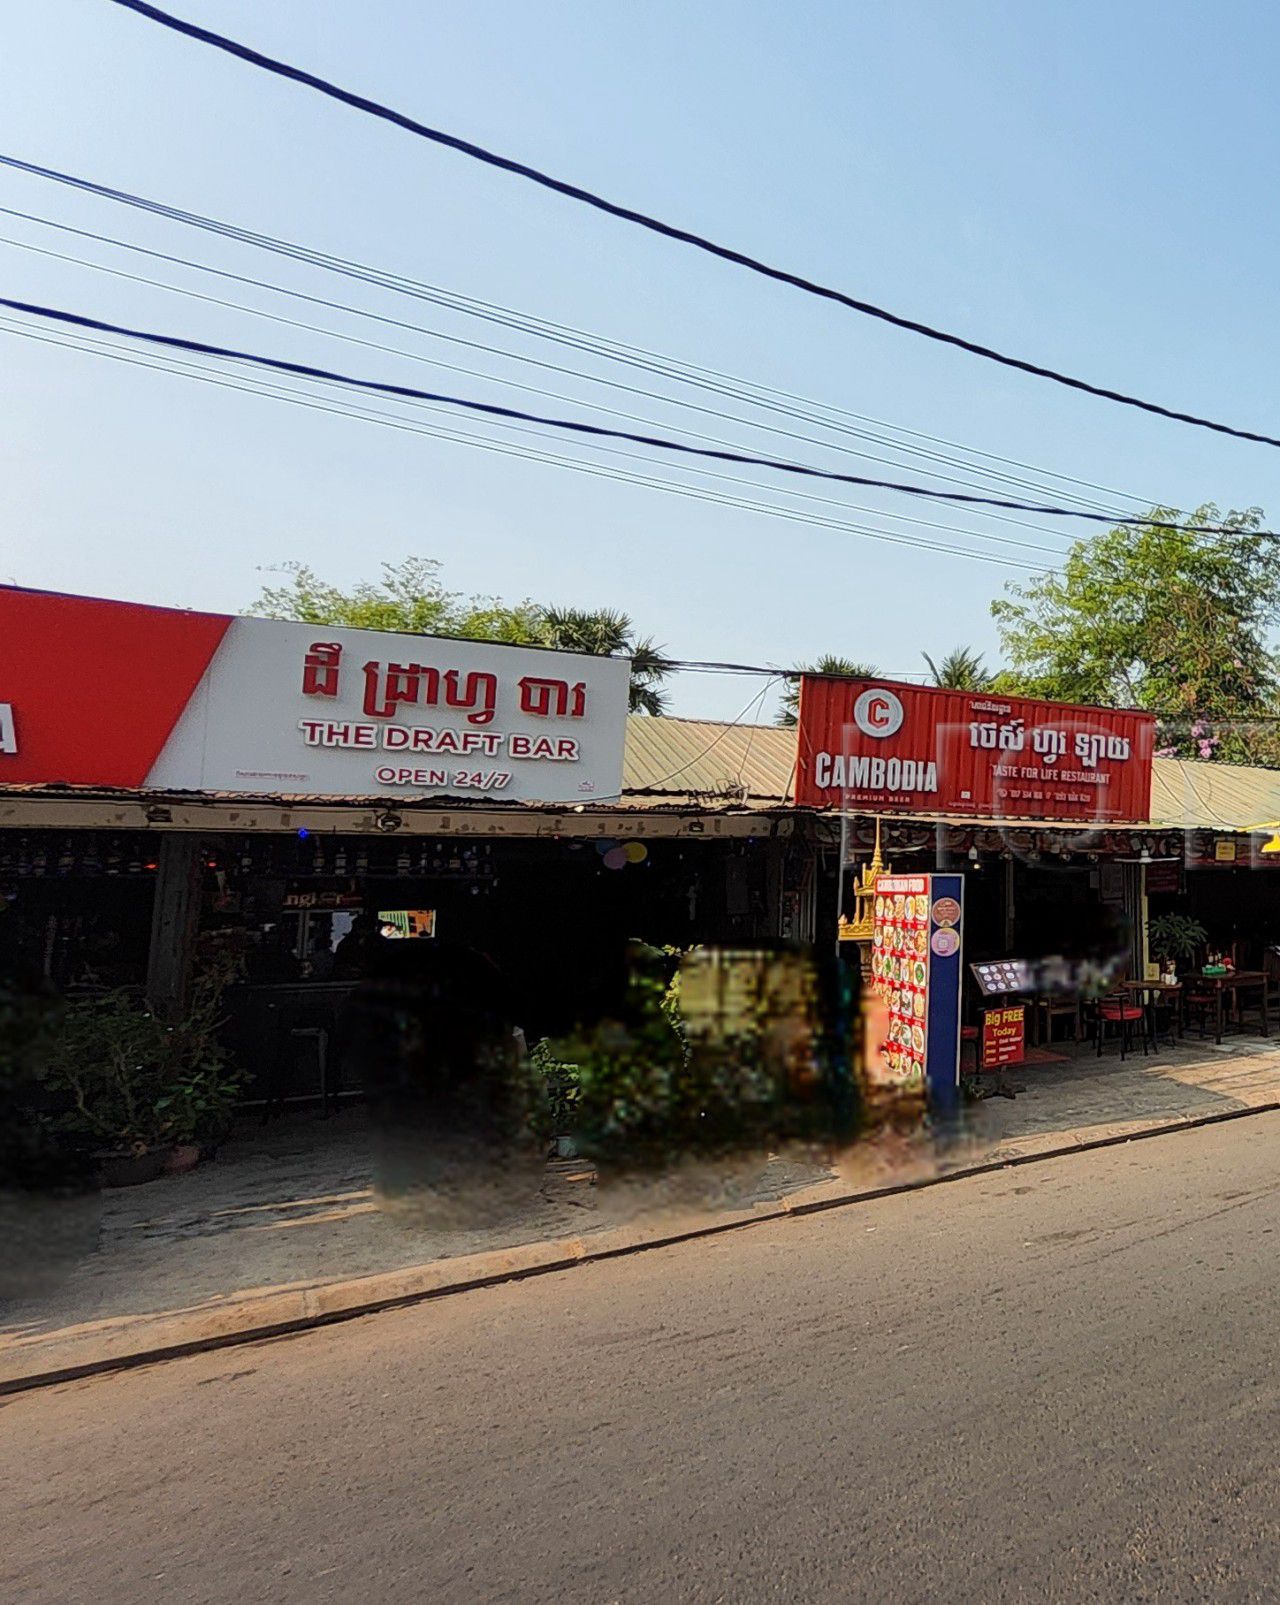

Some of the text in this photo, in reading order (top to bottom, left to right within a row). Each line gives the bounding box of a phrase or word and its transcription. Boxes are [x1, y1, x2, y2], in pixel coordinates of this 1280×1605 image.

[517, 675, 587, 717] បារ
[301, 721, 578, 759] THE DRAFT BAR
[377, 767, 511, 789] OPEN 24/7
[815, 751, 938, 792] CAMBODIA
[991, 764, 1110, 784] TASTE FOR LIFE RESTAURANT
[1003, 1009, 1024, 1023] FREE
[992, 1027, 1017, 1037] Today
